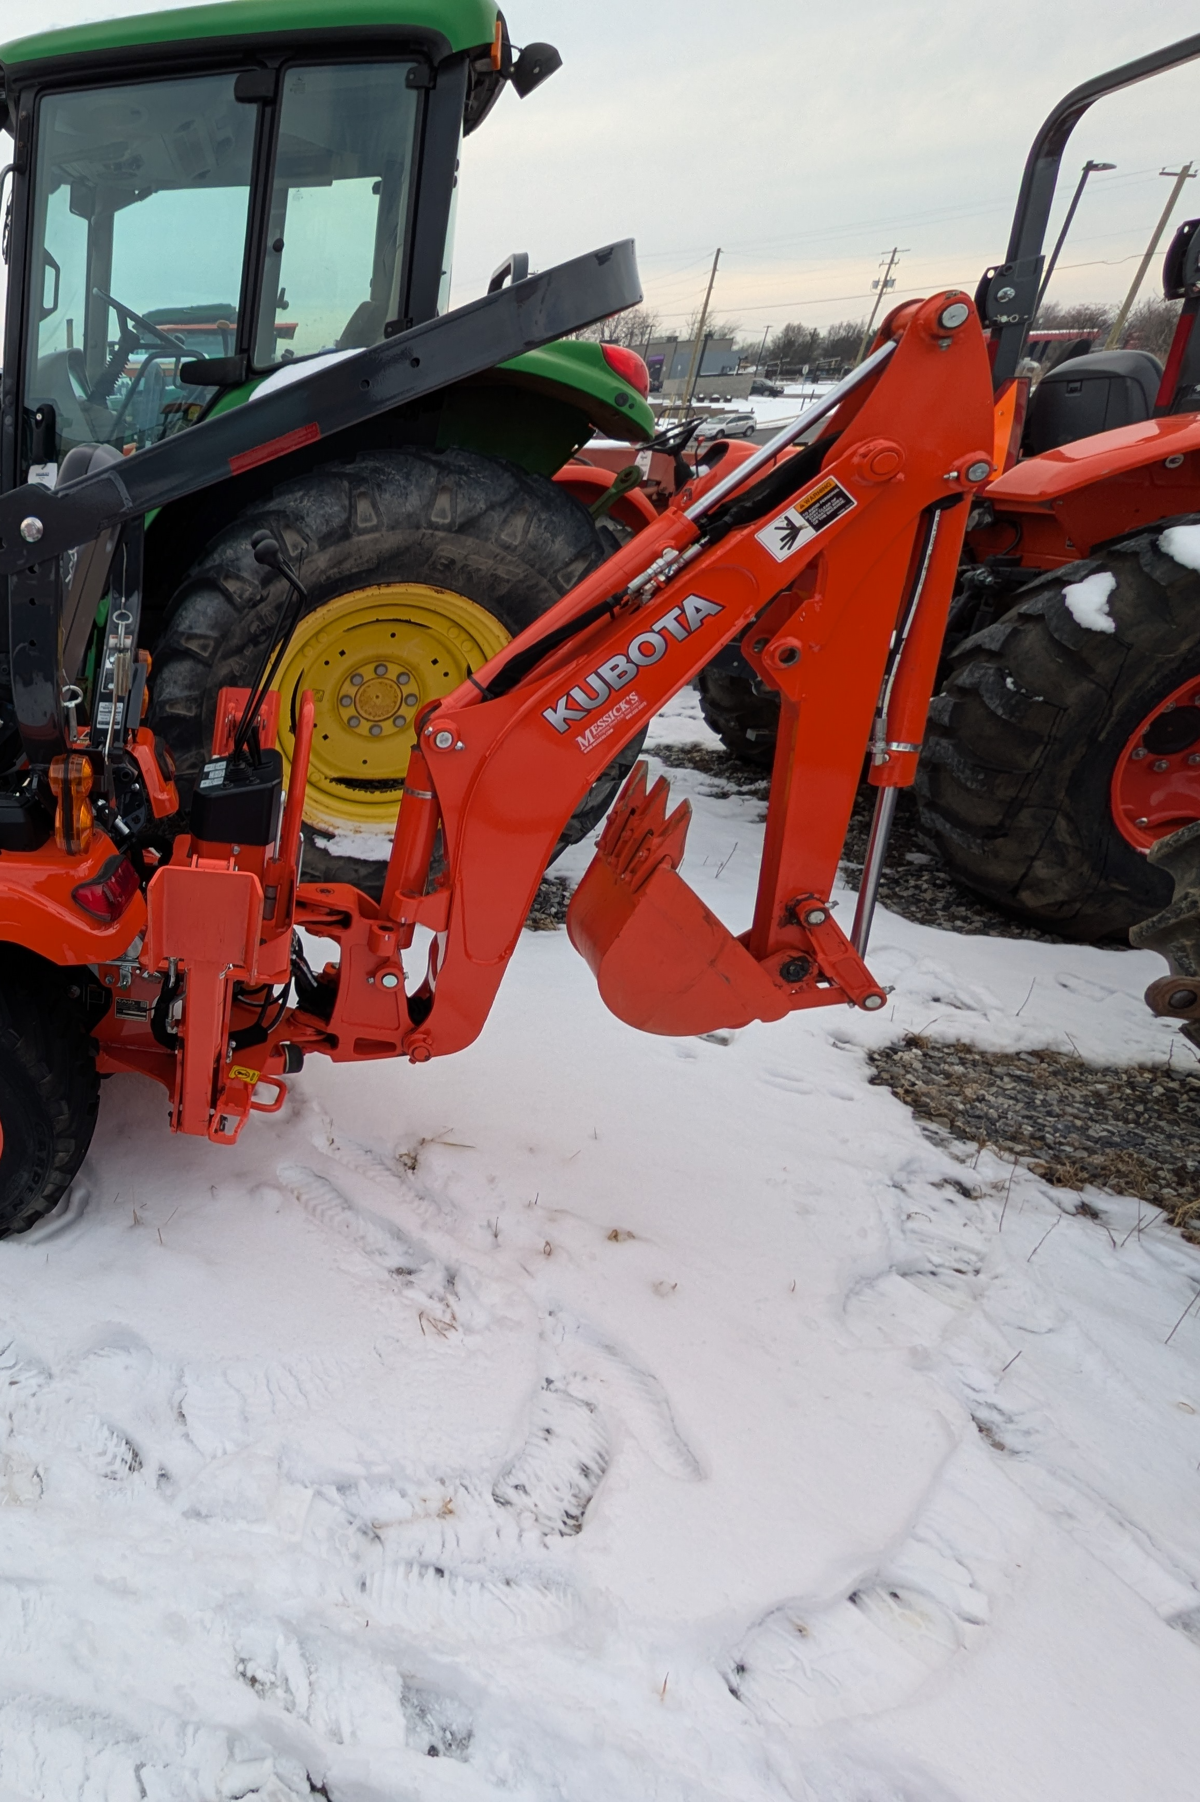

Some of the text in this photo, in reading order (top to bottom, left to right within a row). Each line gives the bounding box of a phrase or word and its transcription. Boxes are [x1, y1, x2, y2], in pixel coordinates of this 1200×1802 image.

[804, 481, 832, 505] WARNING
[542, 593, 726, 735] KUBOTA
[575, 690, 639, 752] MESSICK'S
